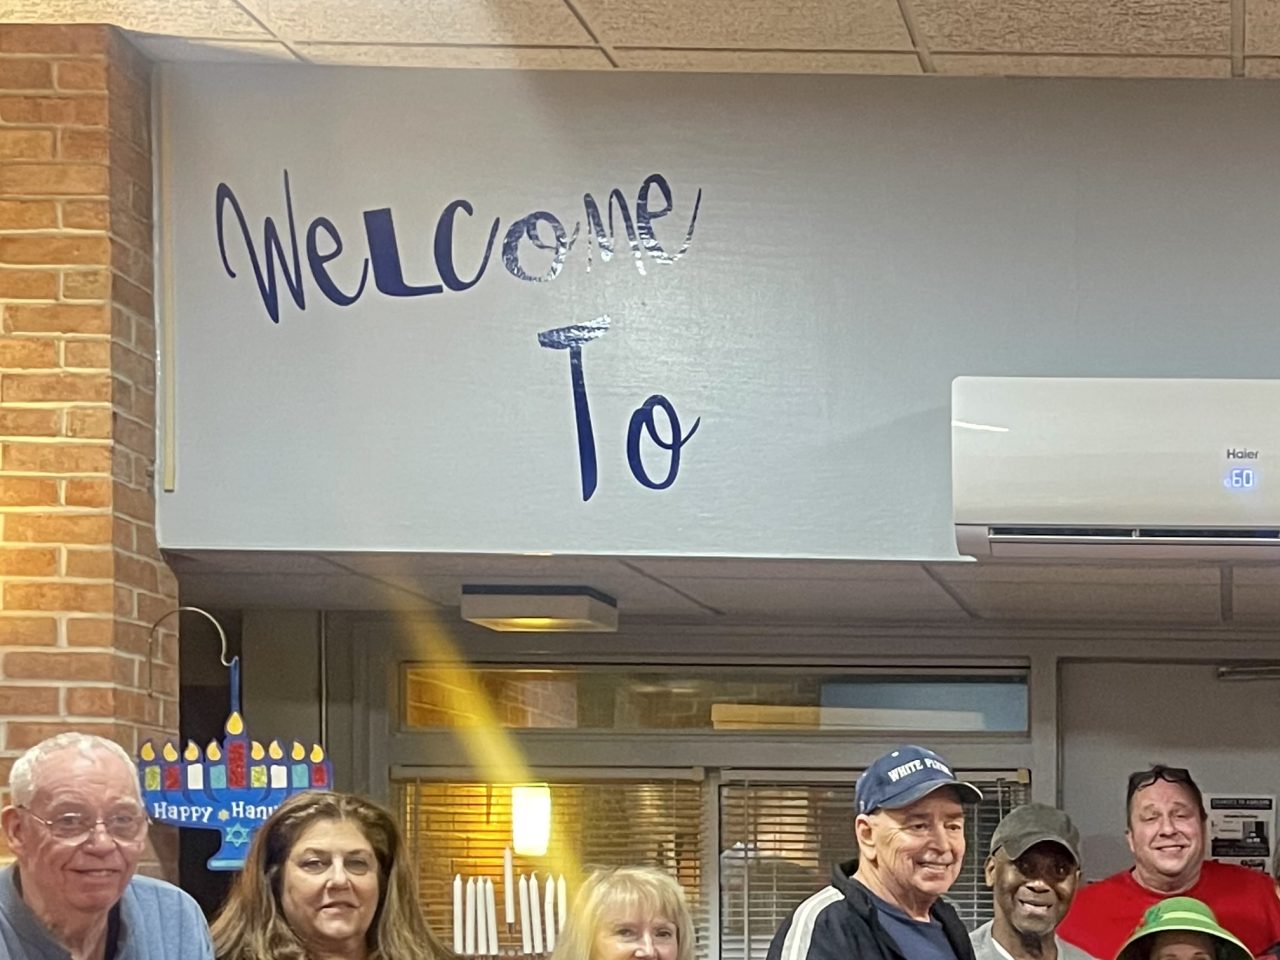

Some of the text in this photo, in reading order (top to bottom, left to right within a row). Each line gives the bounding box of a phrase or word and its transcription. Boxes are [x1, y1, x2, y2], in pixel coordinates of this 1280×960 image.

[537, 315, 701, 502] To
[1226, 448, 1259, 459] Haier
[1231, 469, 1253, 487] 60
[888, 759, 923, 782] WHITE
[153, 801, 213, 823] Happy
